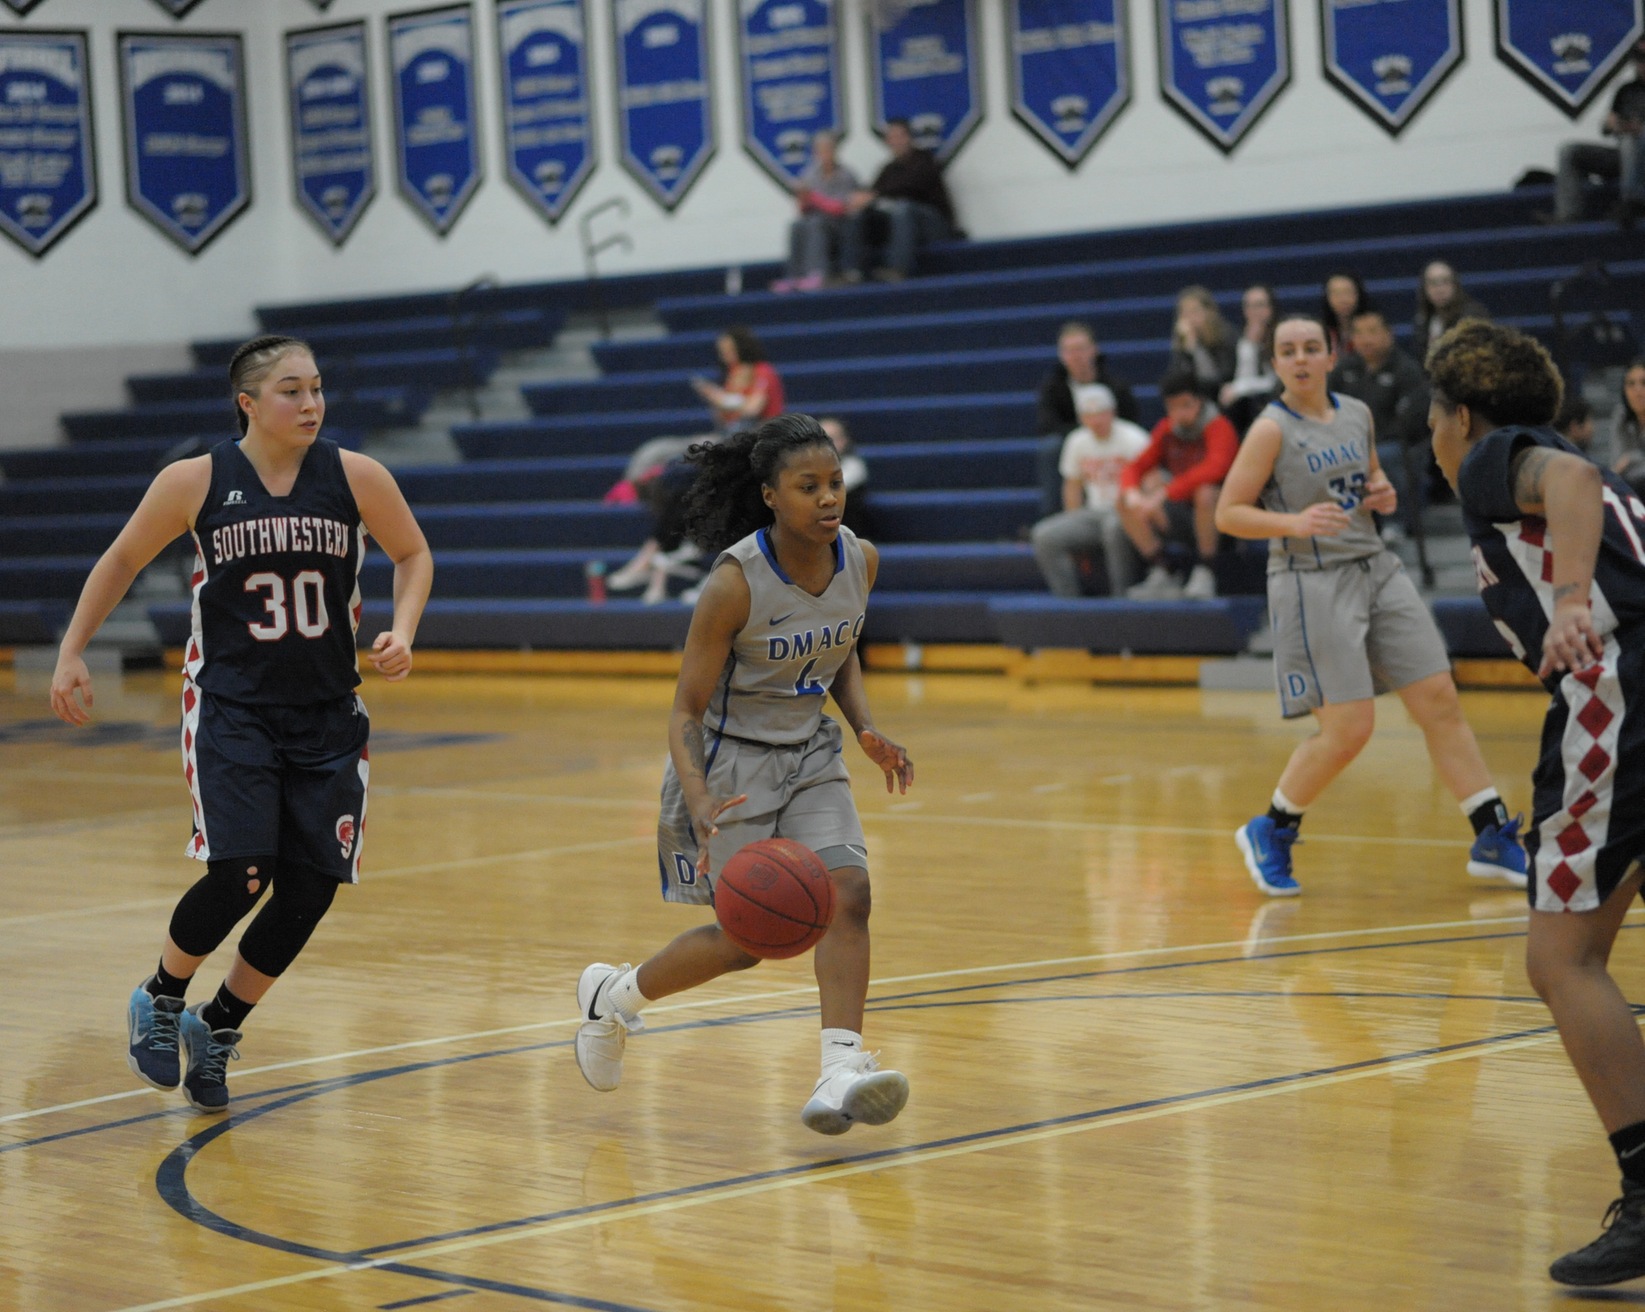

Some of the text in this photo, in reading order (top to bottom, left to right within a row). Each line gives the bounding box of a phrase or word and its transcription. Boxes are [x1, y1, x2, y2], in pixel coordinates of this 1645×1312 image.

[212, 516, 349, 565] SOUTHWESTERN
[243, 569, 331, 643] 30
[1286, 672, 1307, 698] D
[672, 851, 697, 887] D
